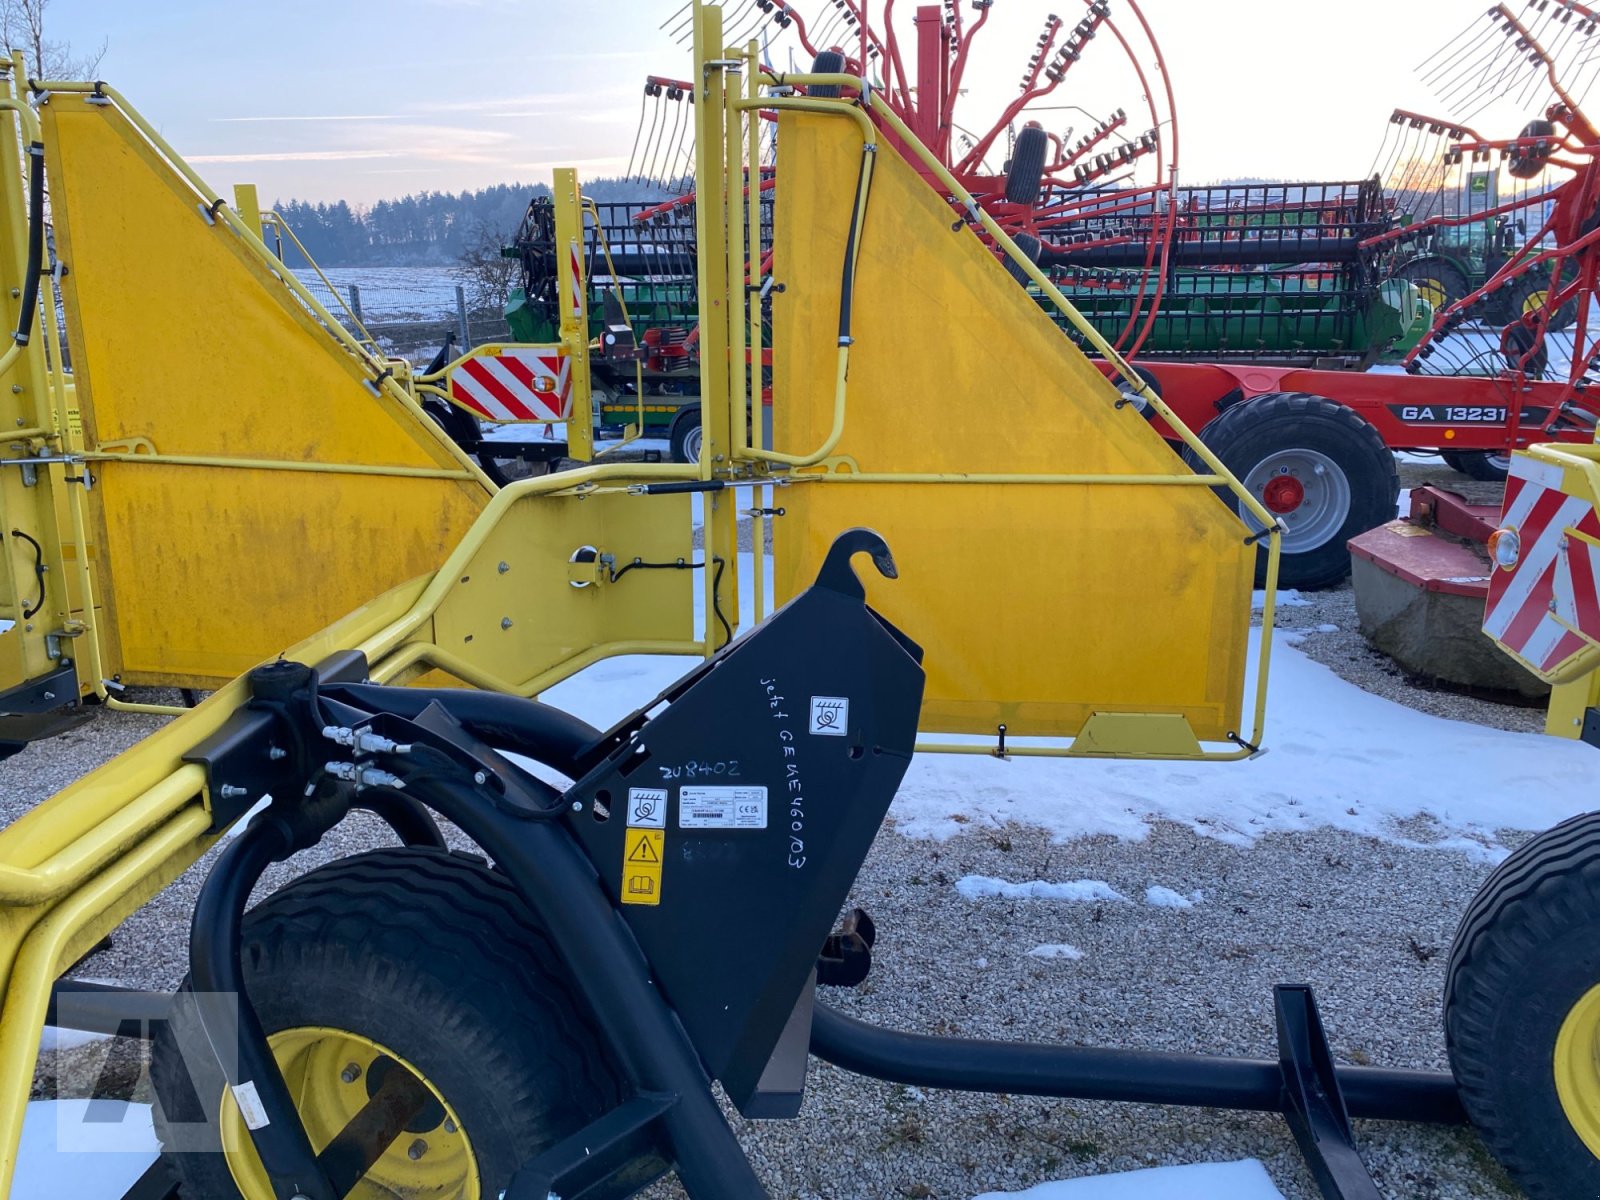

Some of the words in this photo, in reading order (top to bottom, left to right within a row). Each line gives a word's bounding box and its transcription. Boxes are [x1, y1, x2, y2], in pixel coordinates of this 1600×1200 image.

[1402, 407, 1434, 420] GA
[1445, 408, 1506, 421] 13231
[760, 679, 789, 719] jetzt
[685, 760, 741, 777] 8402
